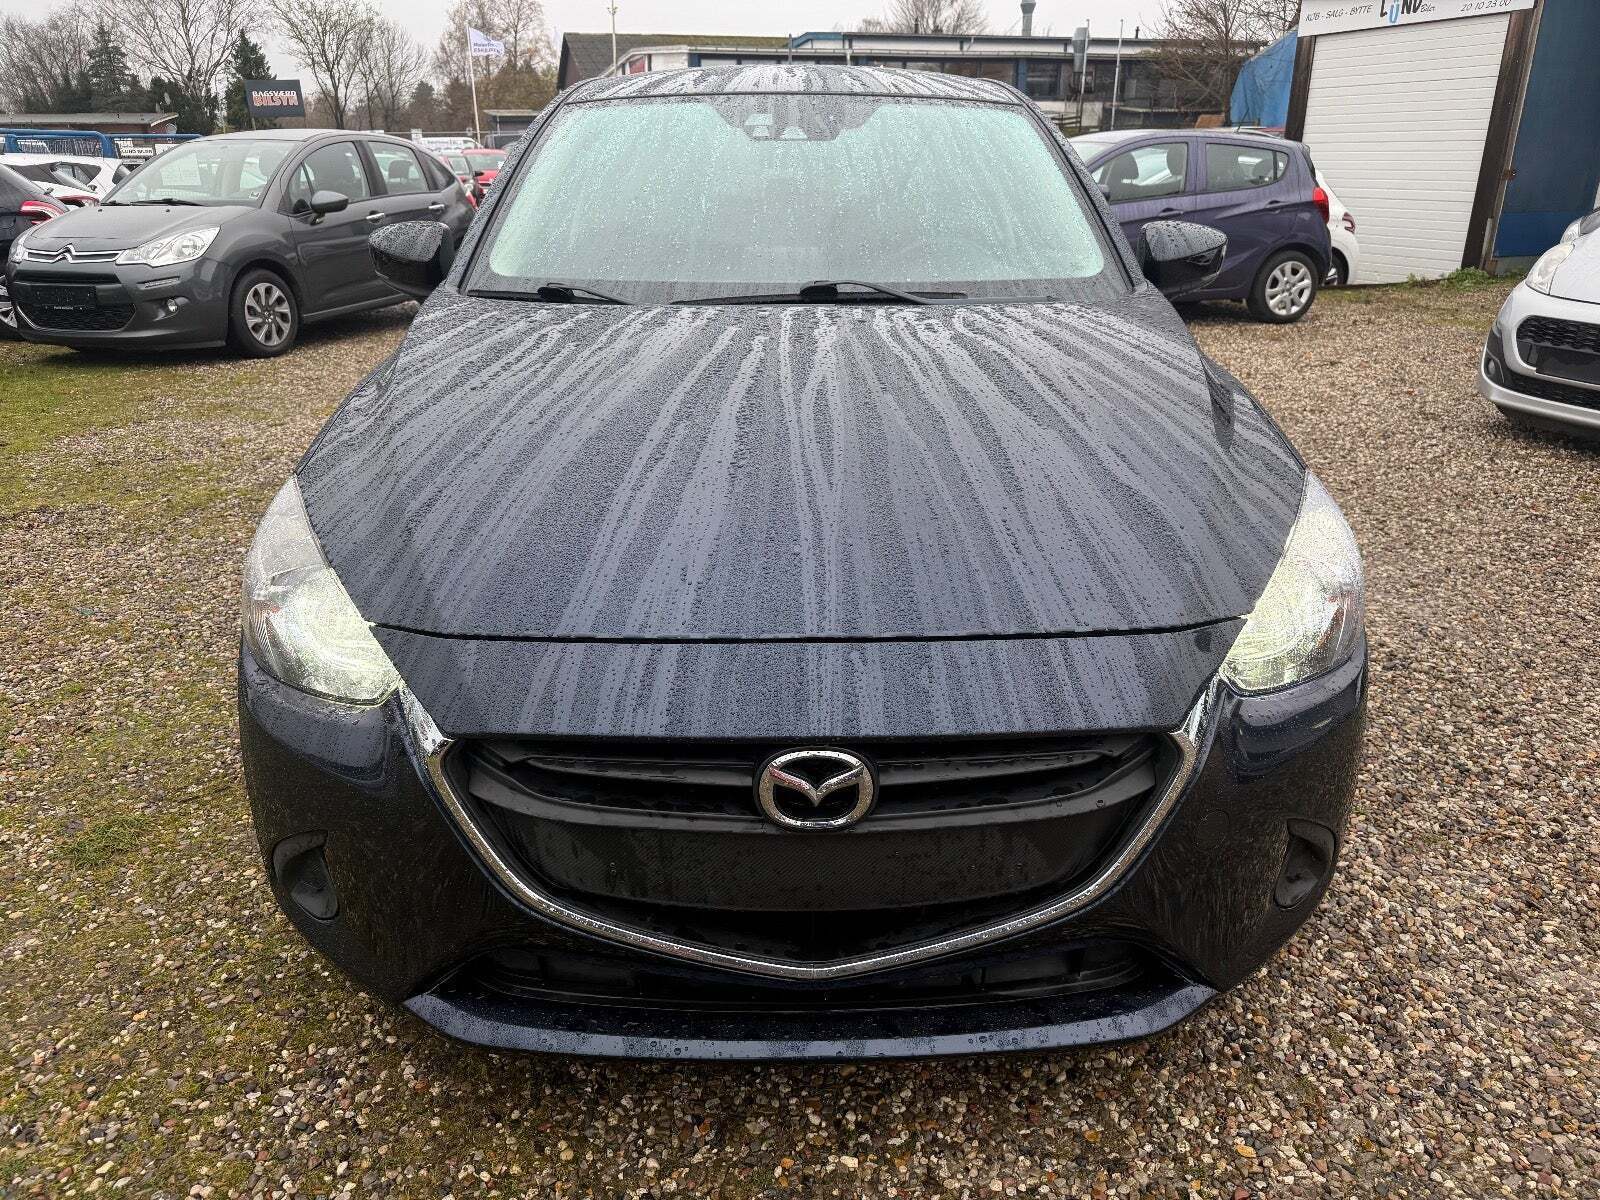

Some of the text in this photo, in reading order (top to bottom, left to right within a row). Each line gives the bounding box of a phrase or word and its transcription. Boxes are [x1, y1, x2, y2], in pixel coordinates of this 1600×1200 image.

[1326, 8, 1344, 19] SALG
[1349, 4, 1373, 16] BYTTE
[252, 95, 299, 106] BILSYN
